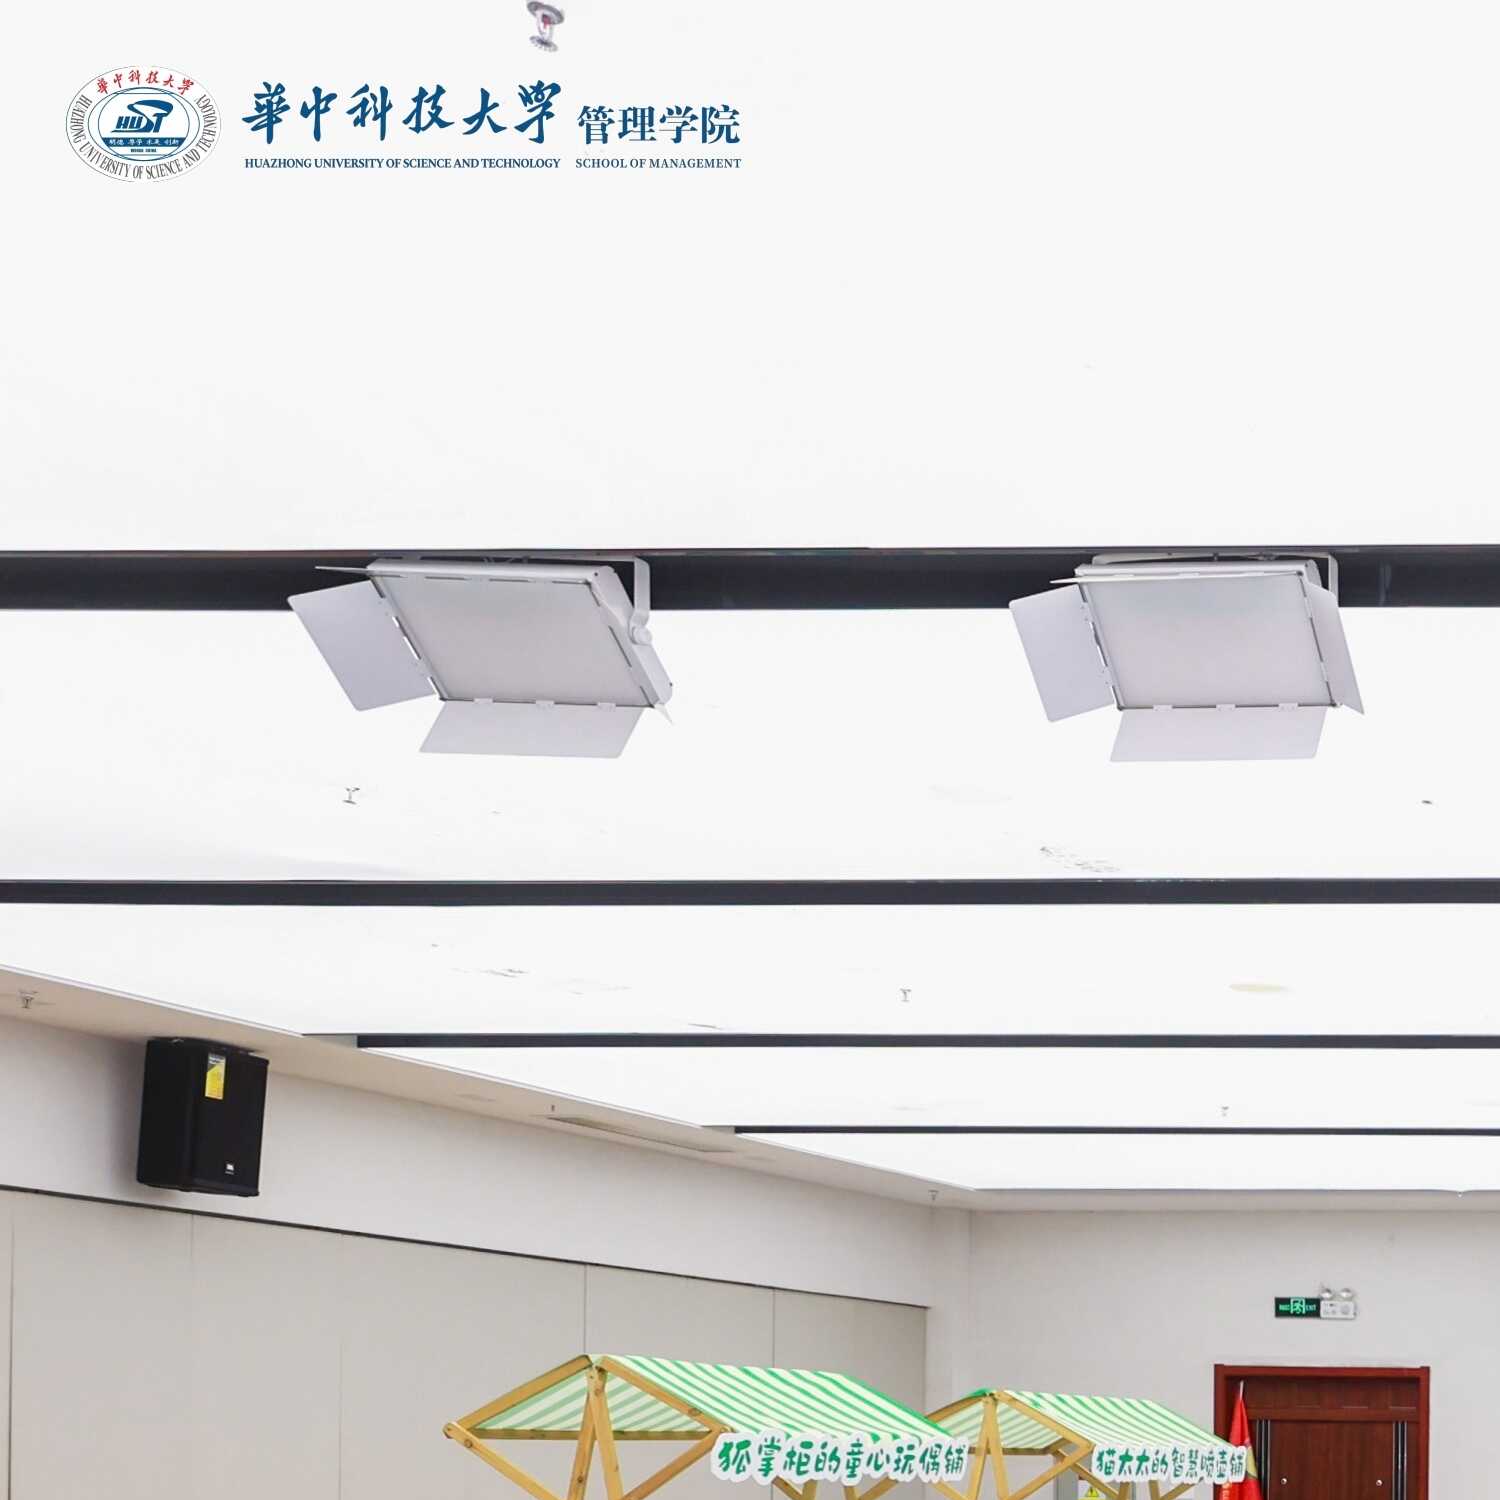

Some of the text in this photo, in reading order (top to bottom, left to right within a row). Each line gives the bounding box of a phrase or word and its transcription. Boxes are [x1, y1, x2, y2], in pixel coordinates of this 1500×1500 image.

[718, 1437, 964, 1478] 狐掌柜的童心玩偶铺
